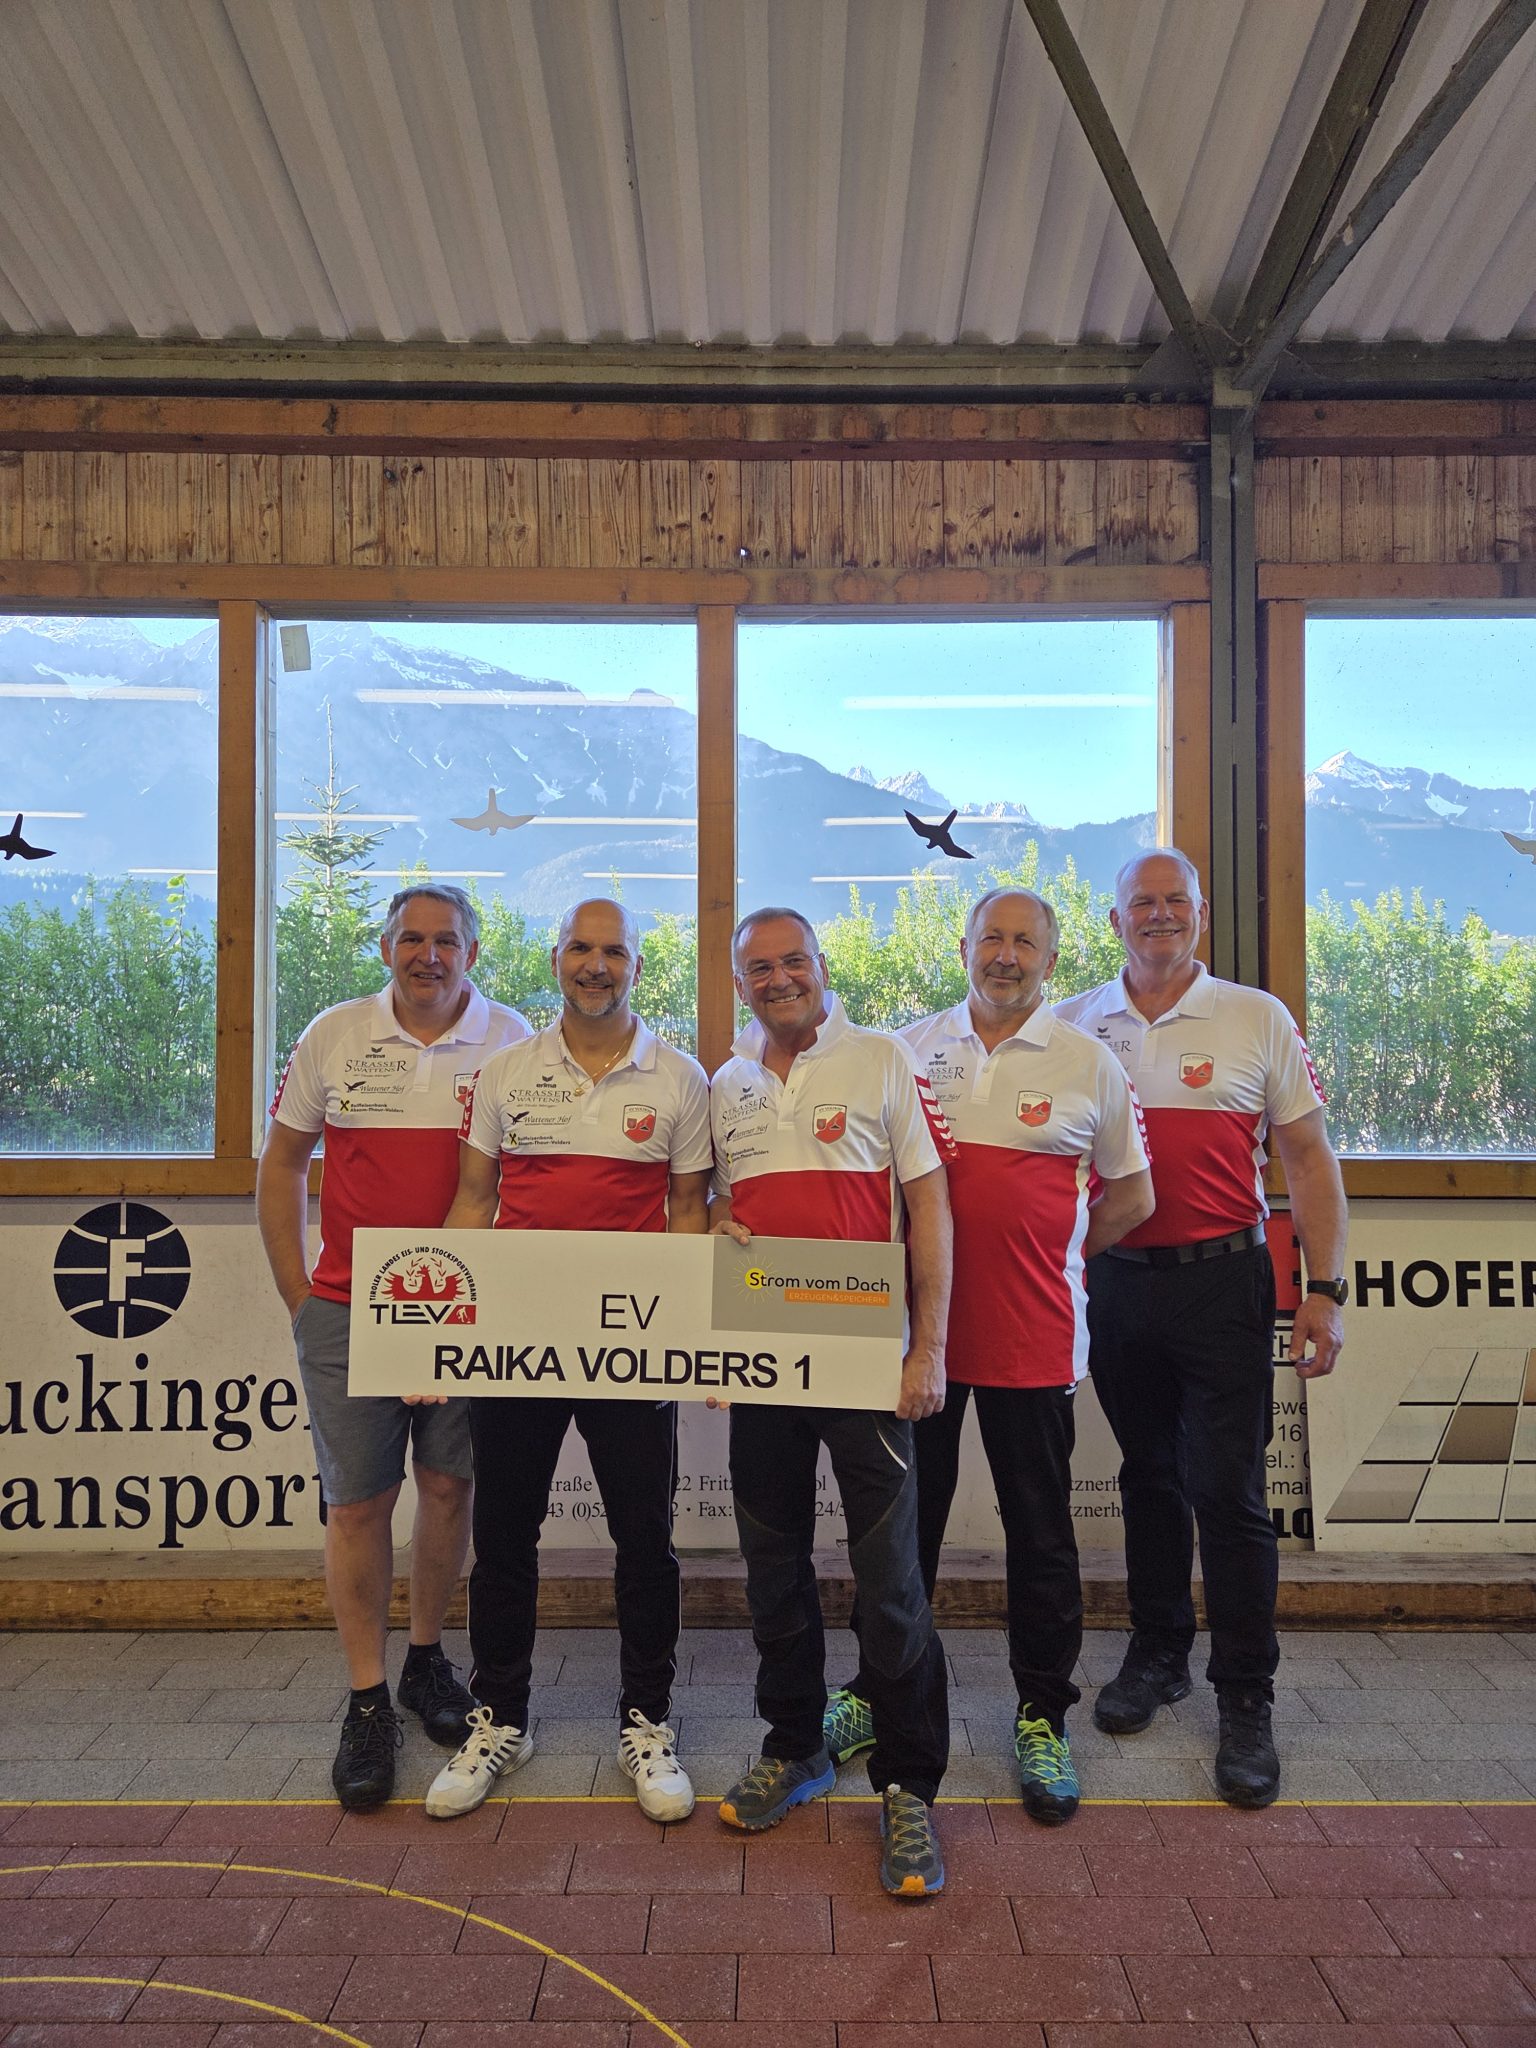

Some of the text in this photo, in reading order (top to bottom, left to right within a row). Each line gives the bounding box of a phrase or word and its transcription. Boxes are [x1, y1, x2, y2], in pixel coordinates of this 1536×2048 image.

[345, 1059, 407, 1073] STRASSER
[506, 1089, 573, 1103] STRASSER
[369, 1274, 382, 1301] TIROLER
[379, 1254, 401, 1274] LANDES
[431, 1247, 477, 1302] STOCKSPORTVERBAND
[750, 1272, 890, 1293] Strom vom Dach
[789, 1292, 886, 1304] ERZEUGEN&SPEICHERN
[600, 1294, 660, 1330] EV
[434, 1345, 811, 1390] RAIKA VOLDERS 1
[0, 1353, 311, 1452] uckinge
[699, 1474, 733, 1491] Frit
[698, 1502, 732, 1517] Fax:
